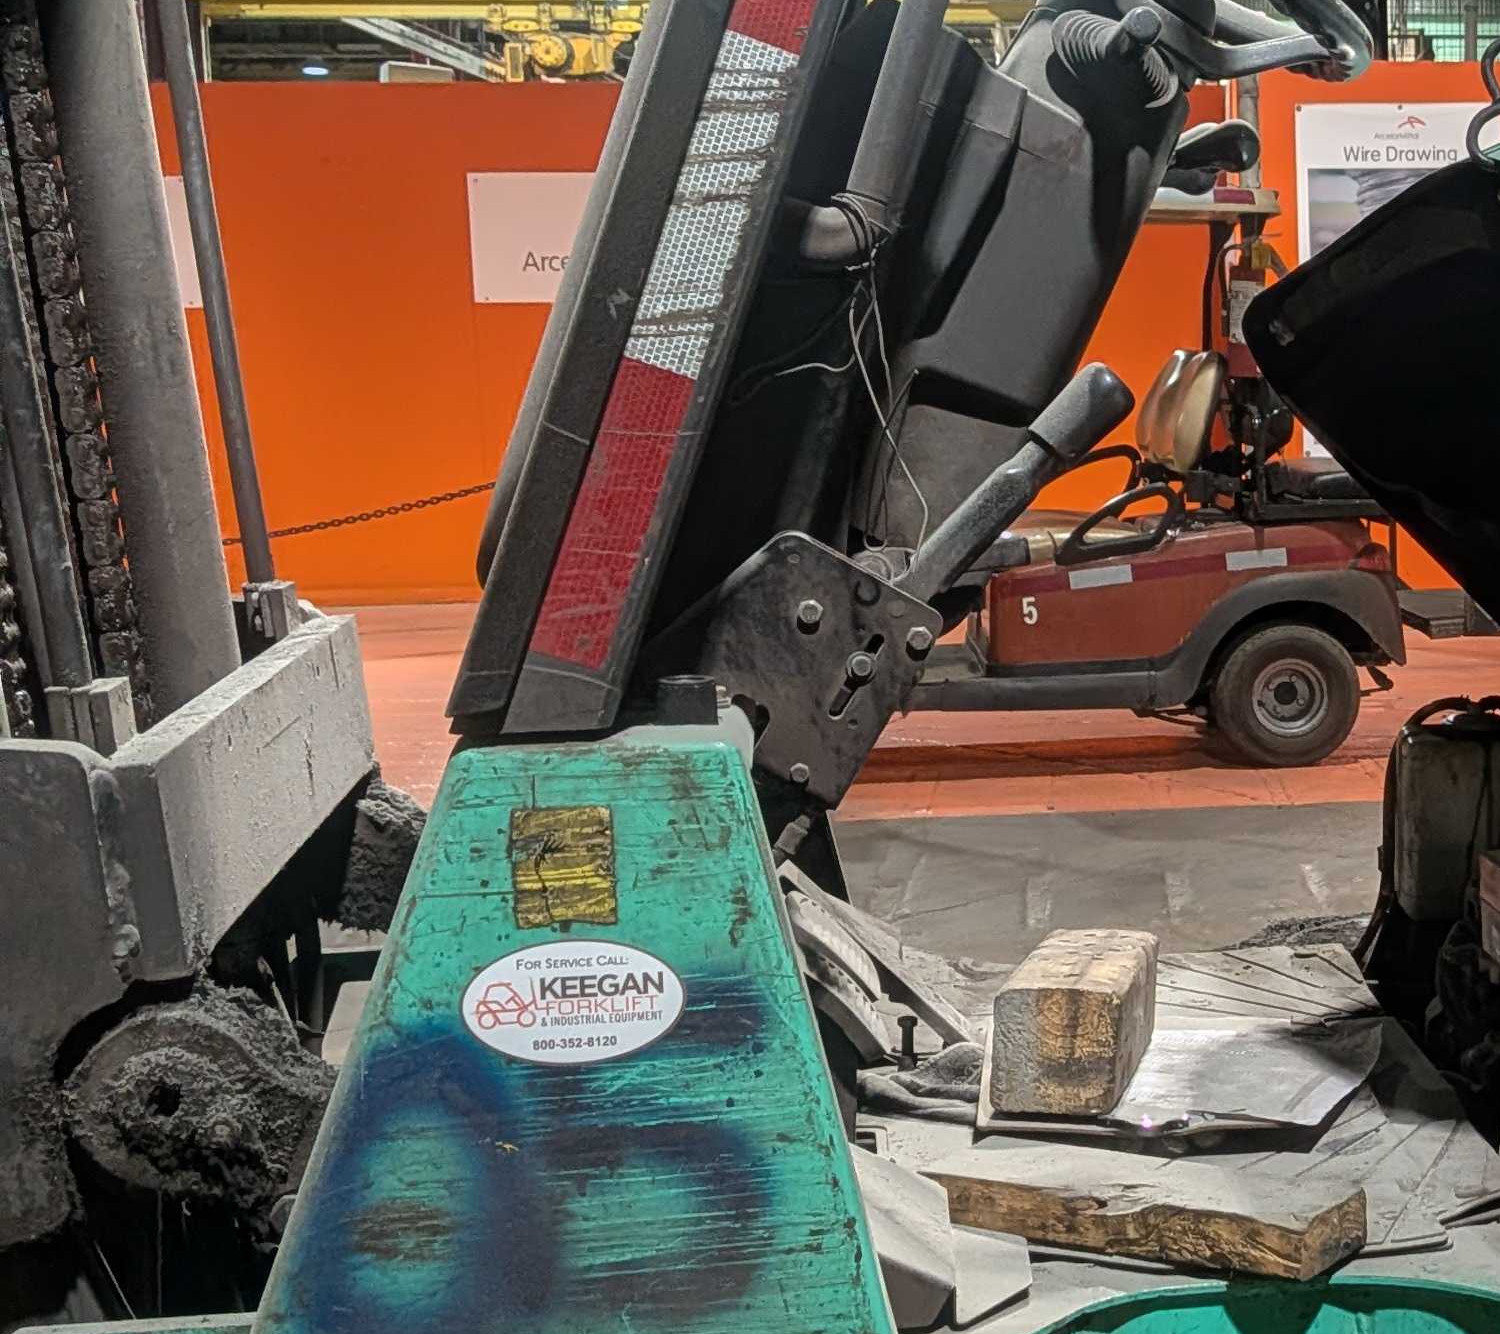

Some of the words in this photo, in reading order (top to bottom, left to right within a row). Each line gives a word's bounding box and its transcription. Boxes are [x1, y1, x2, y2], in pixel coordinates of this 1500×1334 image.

[1343, 145, 1381, 163] Wire
[1386, 145, 1458, 163] Drawing
[1022, 596, 1038, 625] 5
[539, 971, 664, 1000] KEEGAN
[545, 995, 659, 1016] FORKLIFT
[541, 1017, 548, 1028] &
[550, 1013, 608, 1027] INDUSTRIAL
[609, 1010, 663, 1024] EQUIPMENT
[532, 1035, 618, 1051] 800-352-8120
